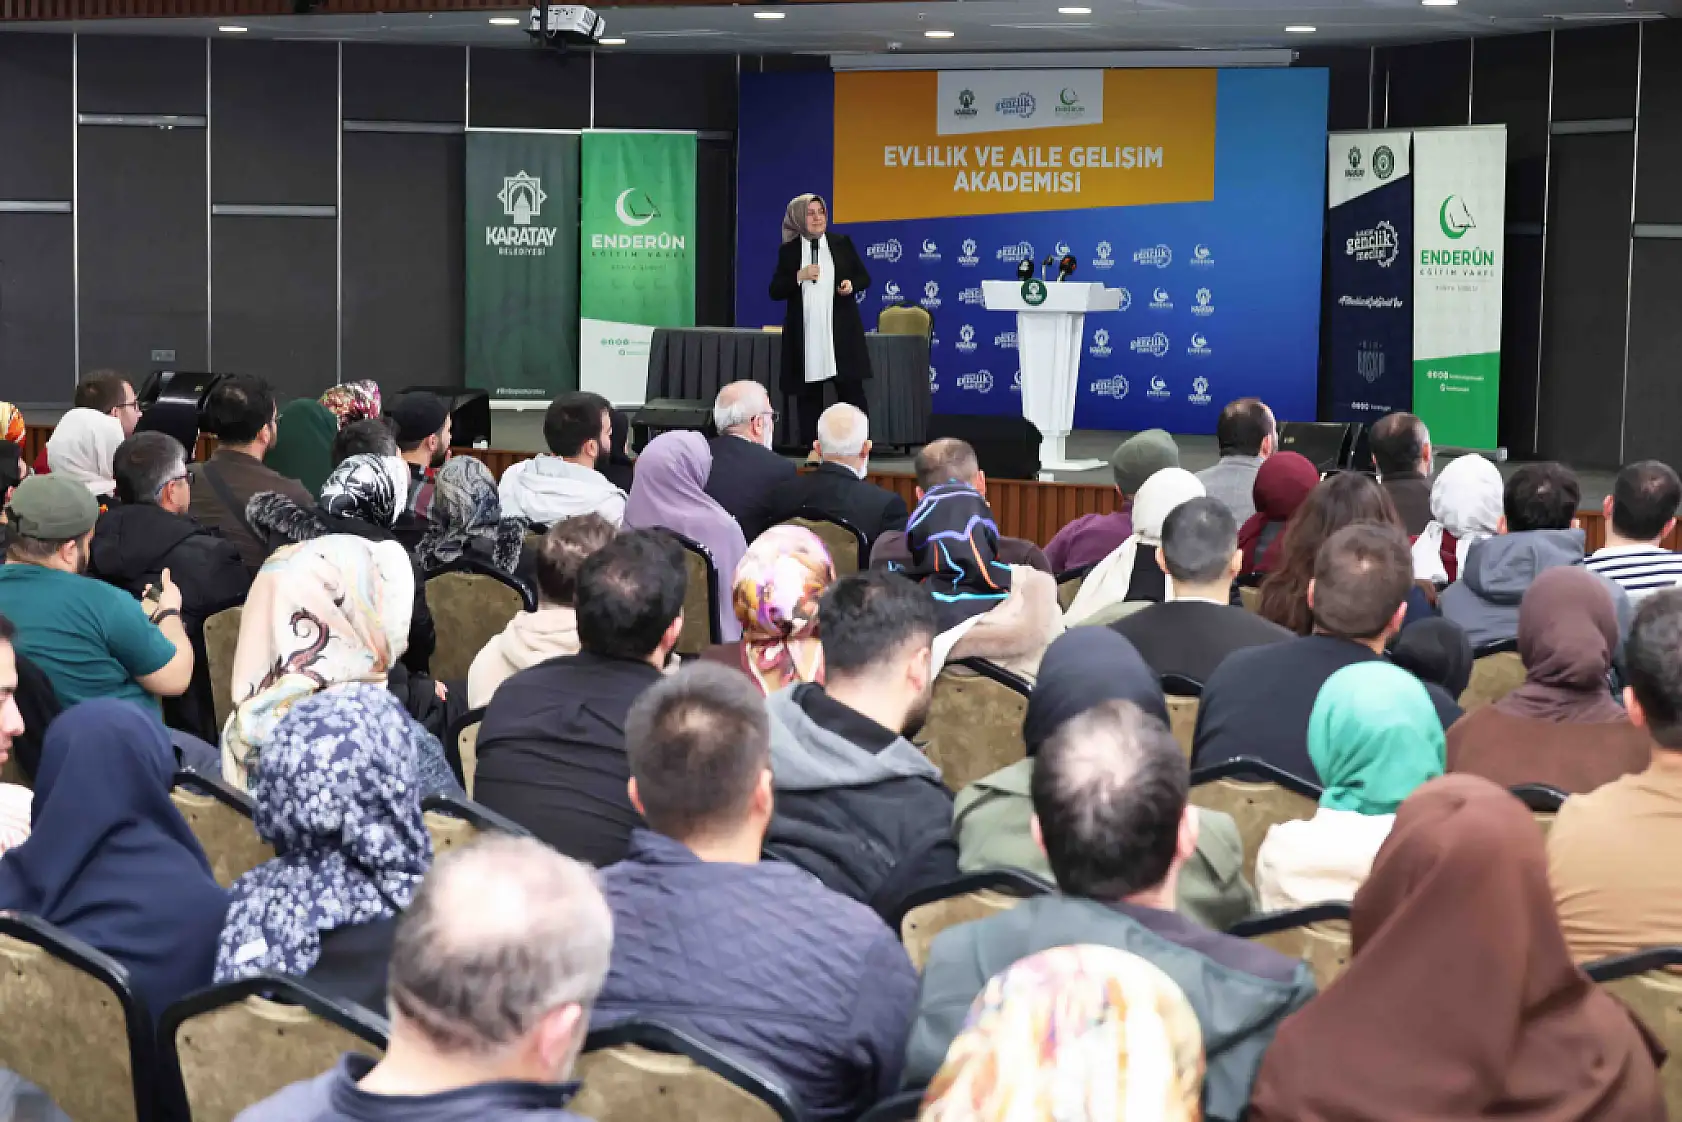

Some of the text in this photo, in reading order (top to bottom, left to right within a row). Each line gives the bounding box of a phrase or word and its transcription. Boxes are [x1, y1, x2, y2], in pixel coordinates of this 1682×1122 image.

[884, 145, 1163, 169] EVLİLİK VE AİLE GELİŞİM
[953, 171, 1081, 193] AKADEMİSİ
[485, 226, 557, 247] KARATAY
[591, 231, 685, 250] ENDERÛN
[1421, 246, 1495, 266] ENDERÛN
